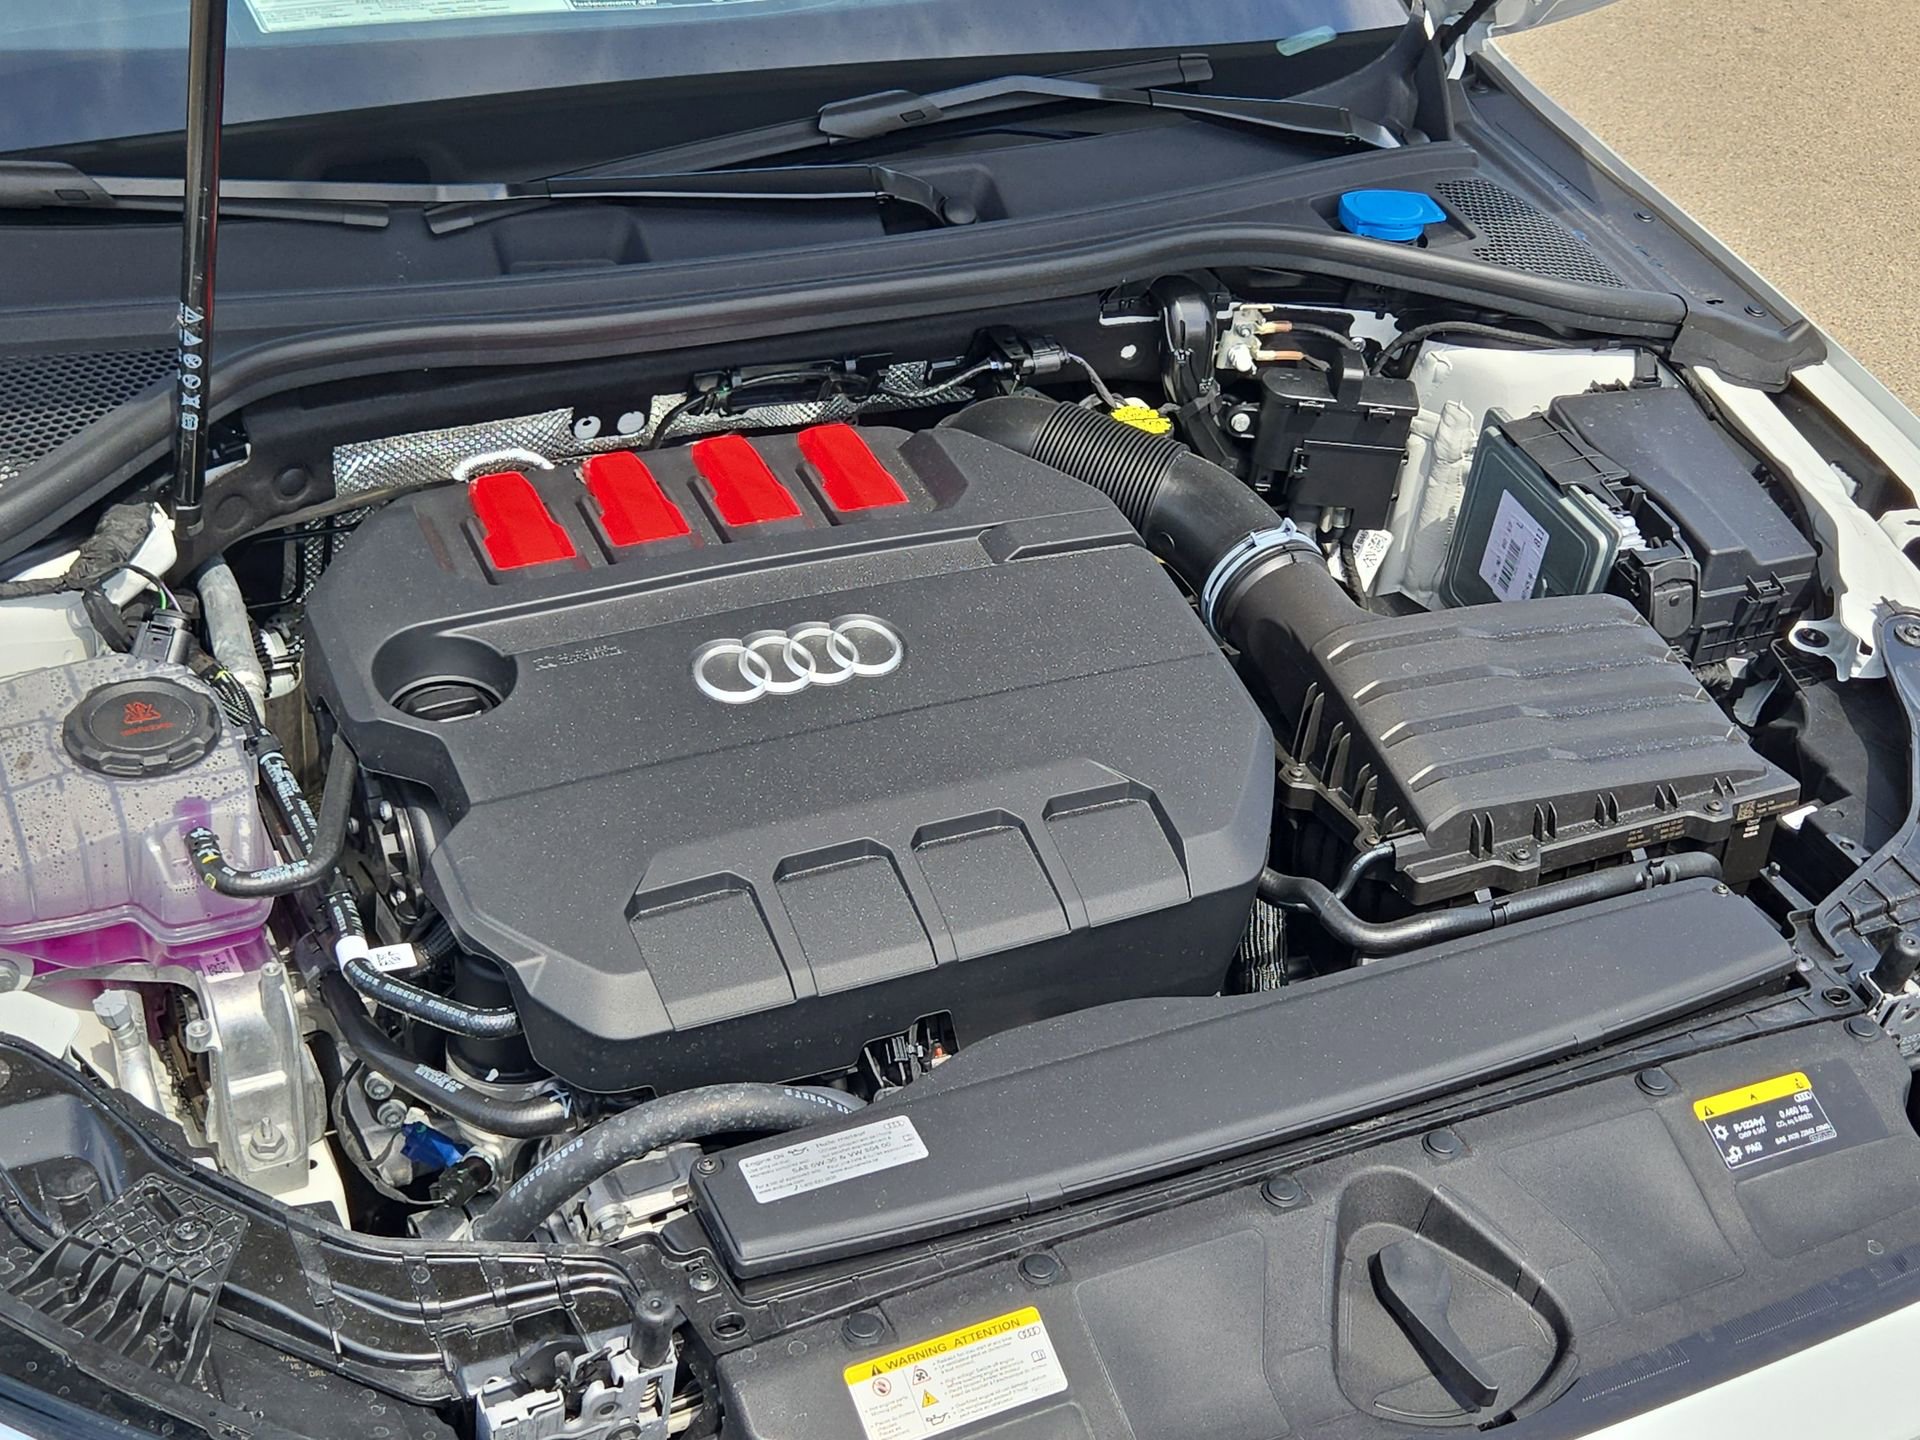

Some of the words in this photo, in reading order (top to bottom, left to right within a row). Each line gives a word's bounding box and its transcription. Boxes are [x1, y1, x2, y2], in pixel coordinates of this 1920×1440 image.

[847, 1149, 863, 1157] VW
[1745, 1141, 1763, 1155] PAG
[885, 1343, 947, 1370] WARNING
[954, 1318, 1021, 1348] ATTENTION
